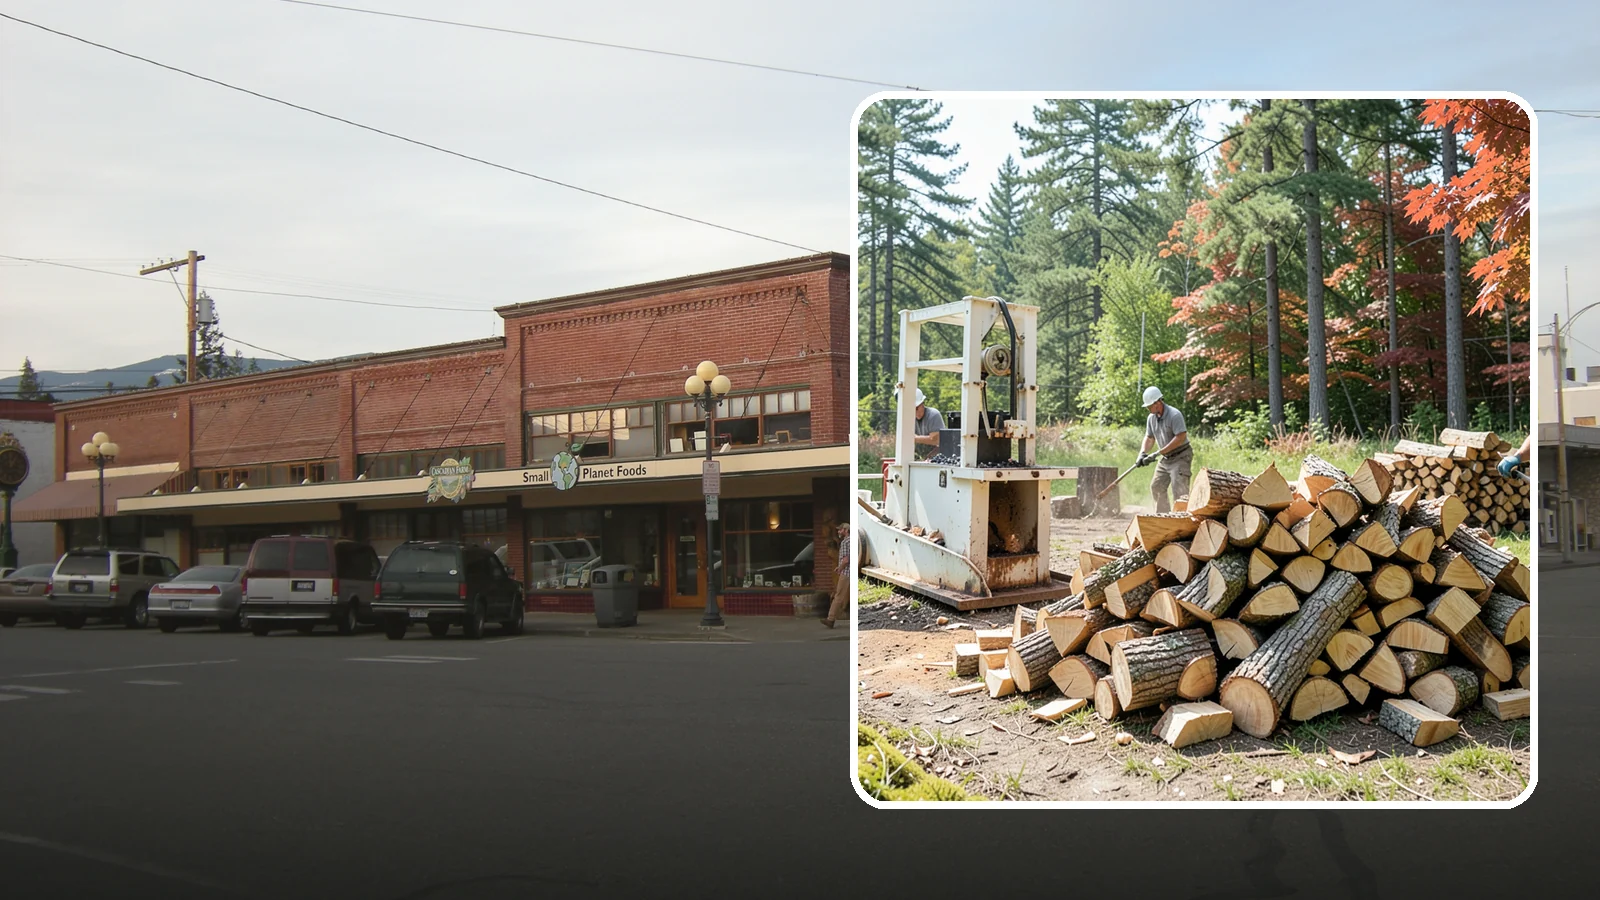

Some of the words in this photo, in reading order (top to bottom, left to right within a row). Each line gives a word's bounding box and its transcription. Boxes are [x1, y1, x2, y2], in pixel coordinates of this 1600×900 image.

[523, 470, 549, 483] Small
[583, 467, 614, 479] Planet
[617, 464, 647, 477] Foods
